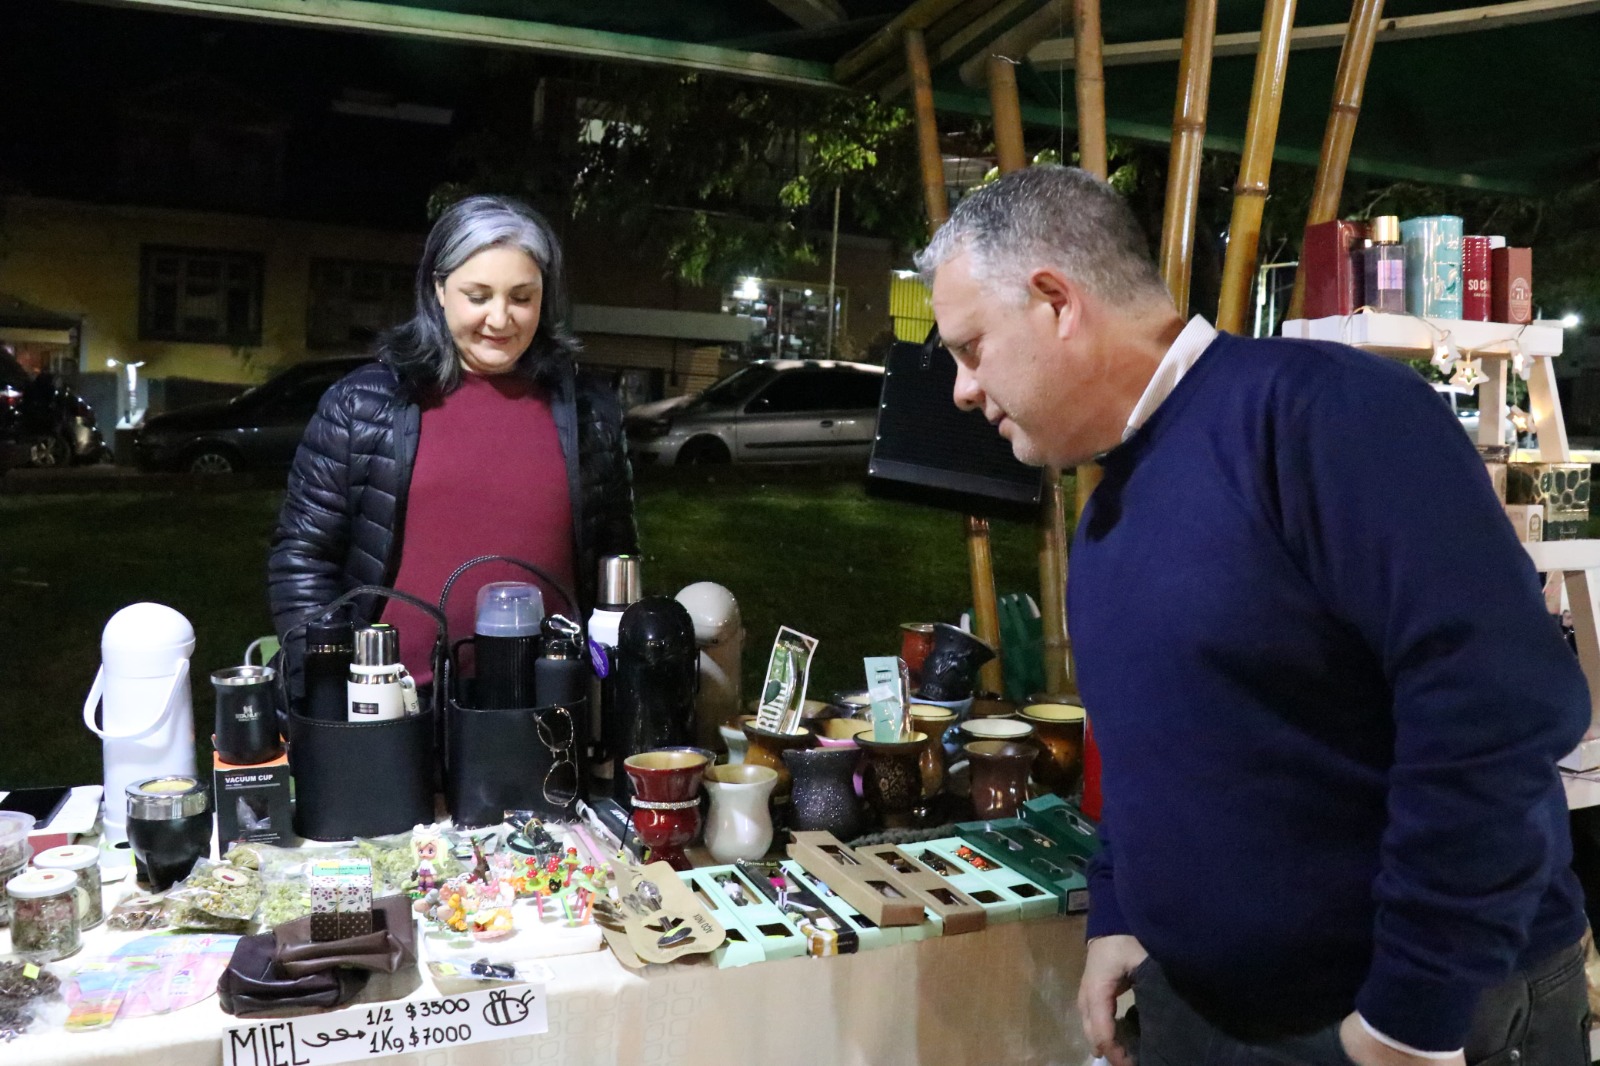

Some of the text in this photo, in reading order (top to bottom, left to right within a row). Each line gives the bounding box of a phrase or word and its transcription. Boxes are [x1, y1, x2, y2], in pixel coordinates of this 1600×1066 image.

[1468, 279, 1478, 291] SO
[225, 774, 273, 784] VACUUM CUP
[366, 998, 470, 1025] 1/2 $3500
[369, 1023, 472, 1053] 1Kg $7000
